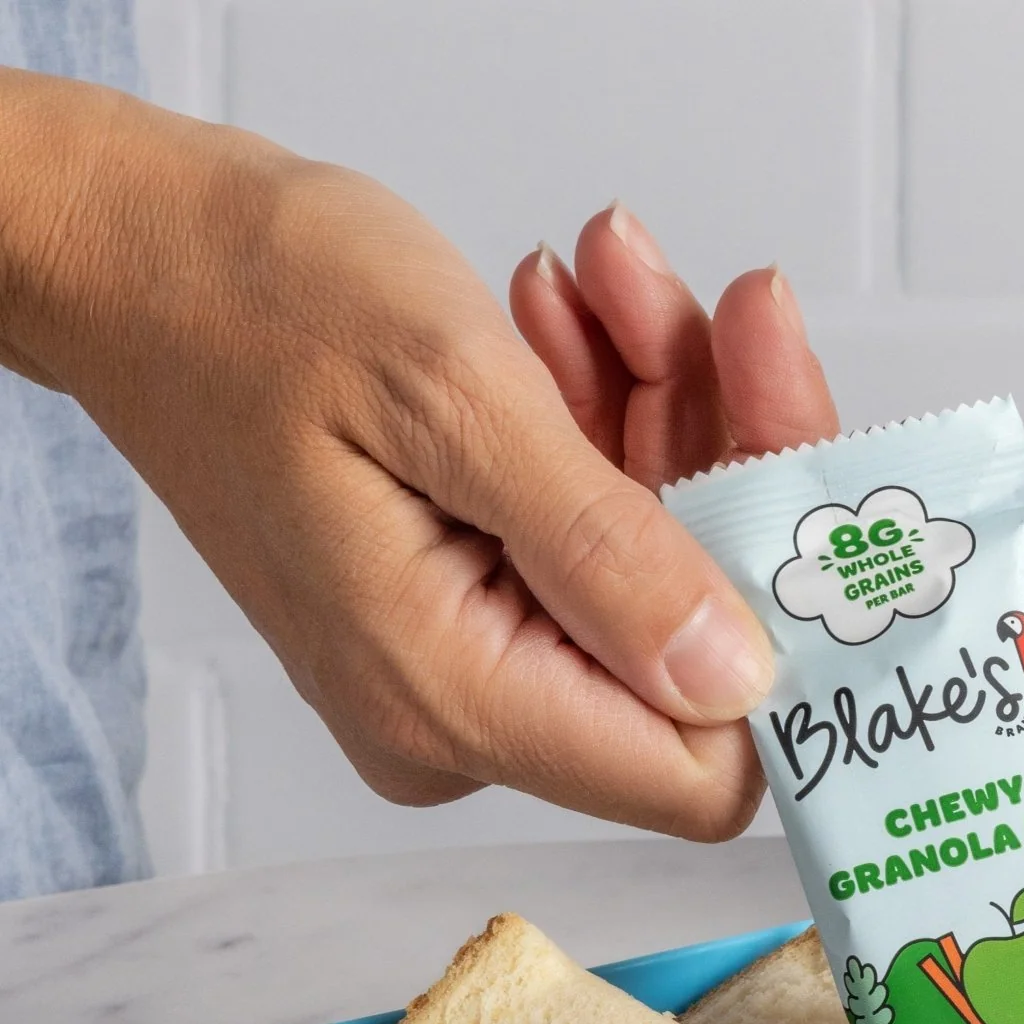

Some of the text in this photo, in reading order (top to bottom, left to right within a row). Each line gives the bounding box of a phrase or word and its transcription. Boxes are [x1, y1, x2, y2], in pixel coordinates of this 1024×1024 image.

[829, 518, 904, 559] 8G
[837, 544, 916, 579] WHOLE
[844, 559, 925, 601] GRAINS
[865, 582, 916, 610] PER BAR
[769, 647, 1023, 801] Blake's
[884, 774, 1023, 838] CHEWY
[828, 823, 1022, 901] GRANOLA
